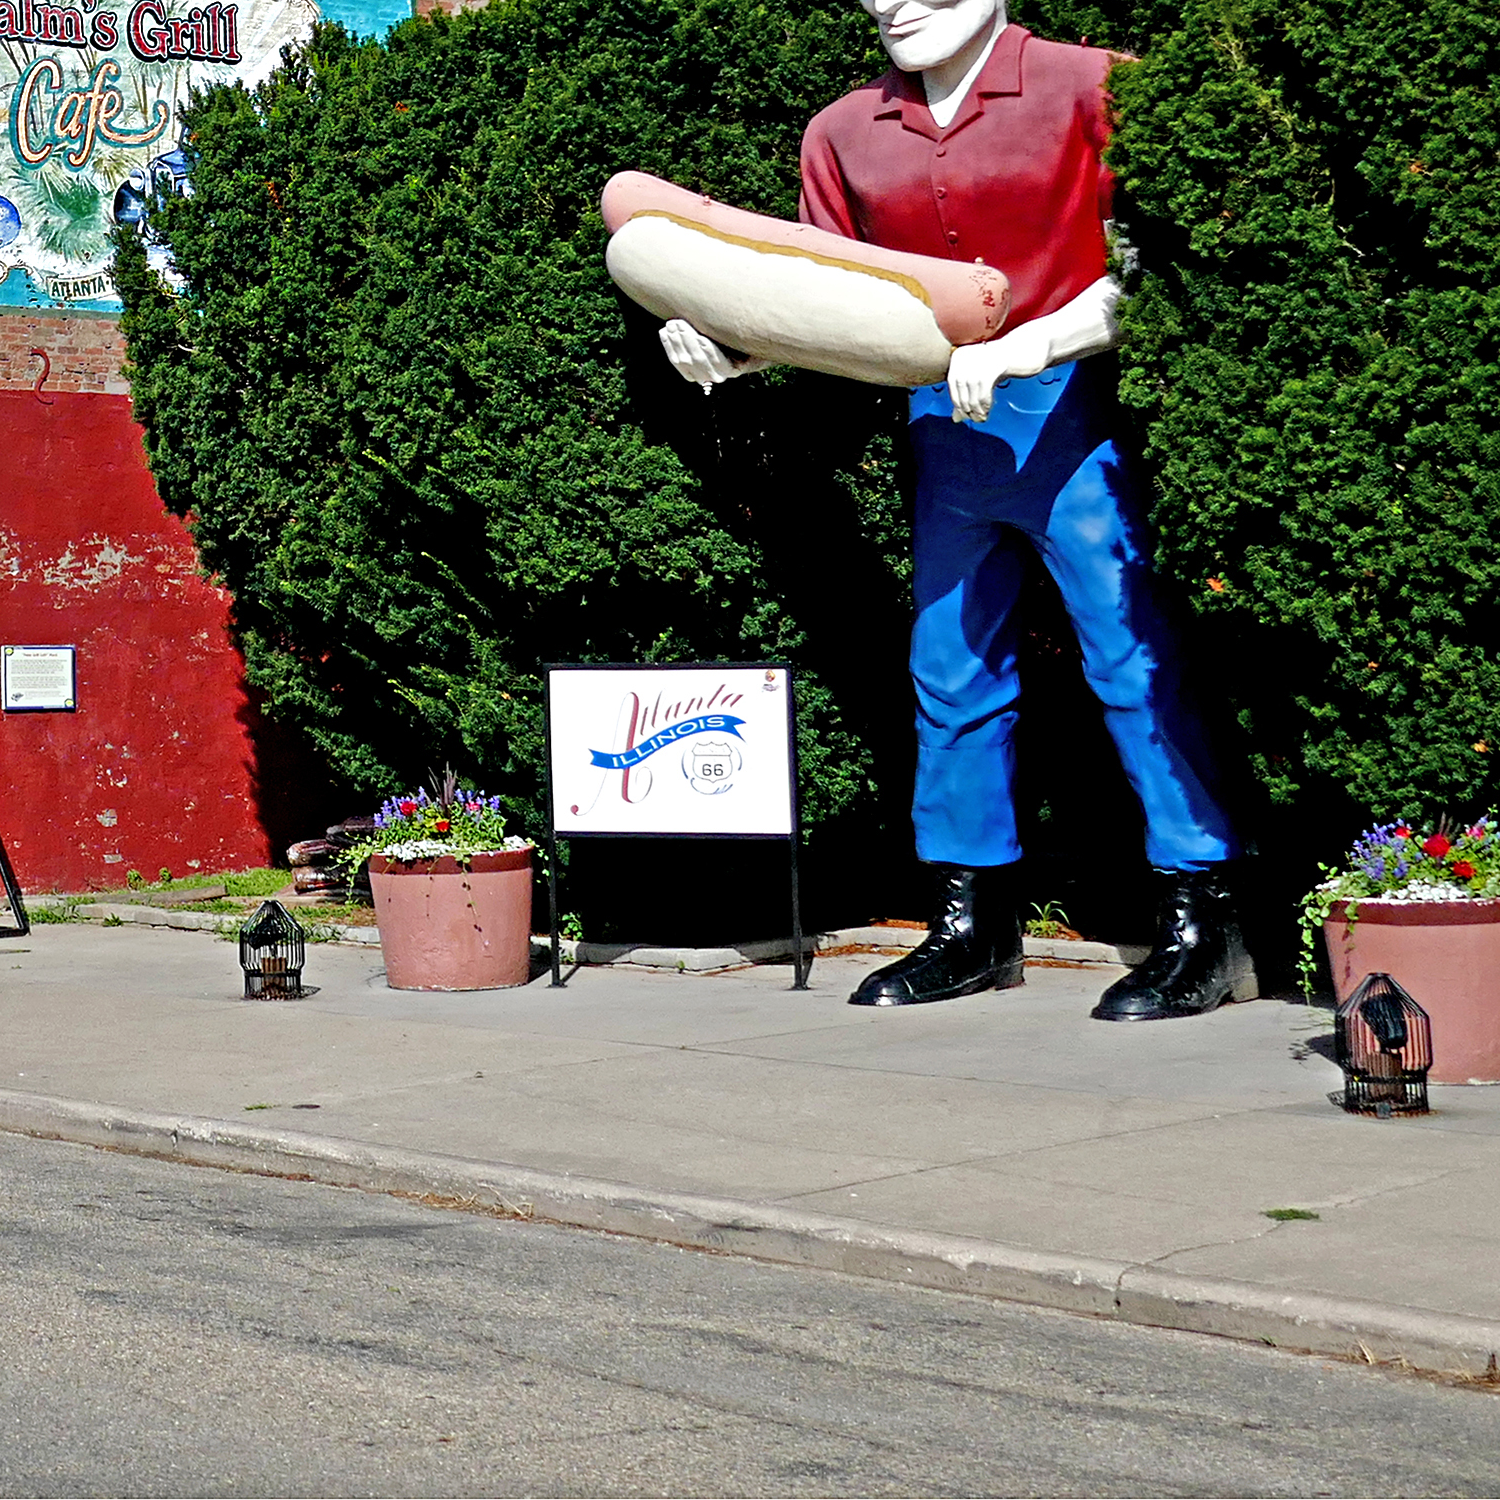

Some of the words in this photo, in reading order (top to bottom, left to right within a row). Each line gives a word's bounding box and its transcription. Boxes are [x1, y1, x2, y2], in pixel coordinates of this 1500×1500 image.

[128, 0, 242, 63] Grill
[9, 56, 169, 171] Cafe
[611, 716, 725, 768] ILLINOIS
[702, 763, 724, 777] 66
